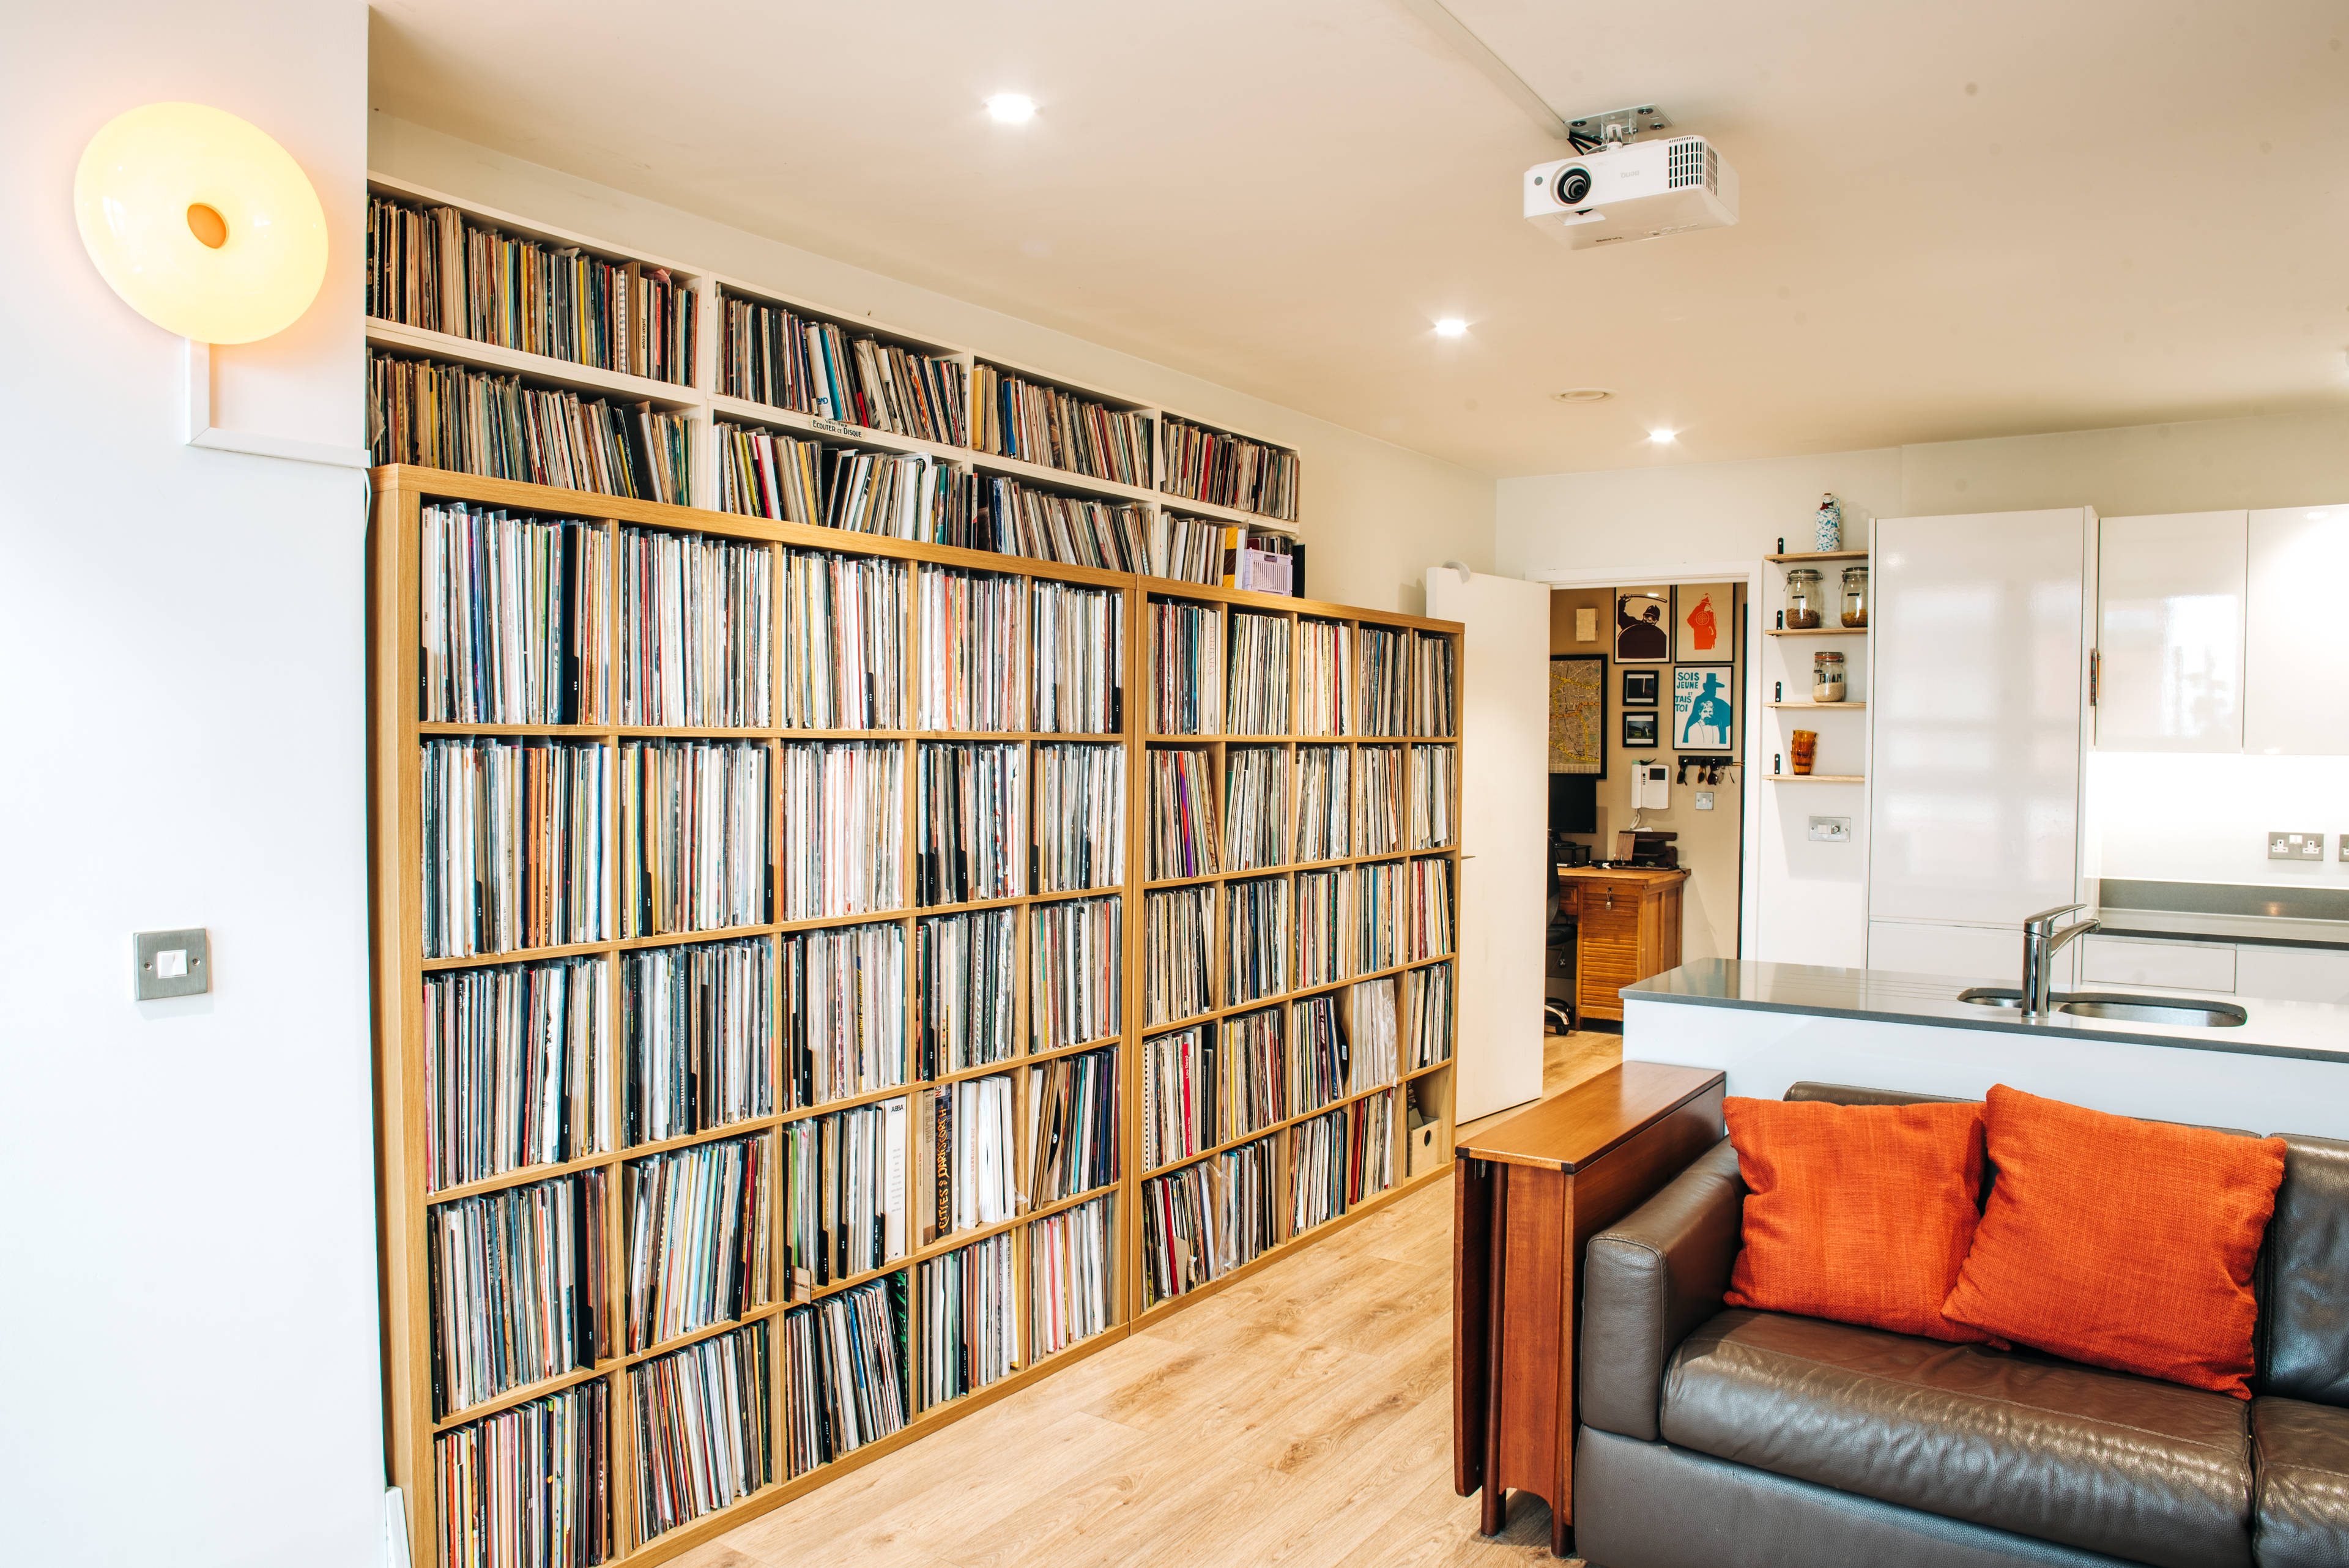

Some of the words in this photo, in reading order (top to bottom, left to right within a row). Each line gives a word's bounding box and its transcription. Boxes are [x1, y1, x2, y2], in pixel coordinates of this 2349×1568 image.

[812, 420, 836, 432] ECOUTER
[844, 427, 862, 437] DISQUE
[1677, 672, 1699, 681] SOIS
[891, 1104, 904, 1113] ABBA
[938, 1189, 950, 1230] CITIES
